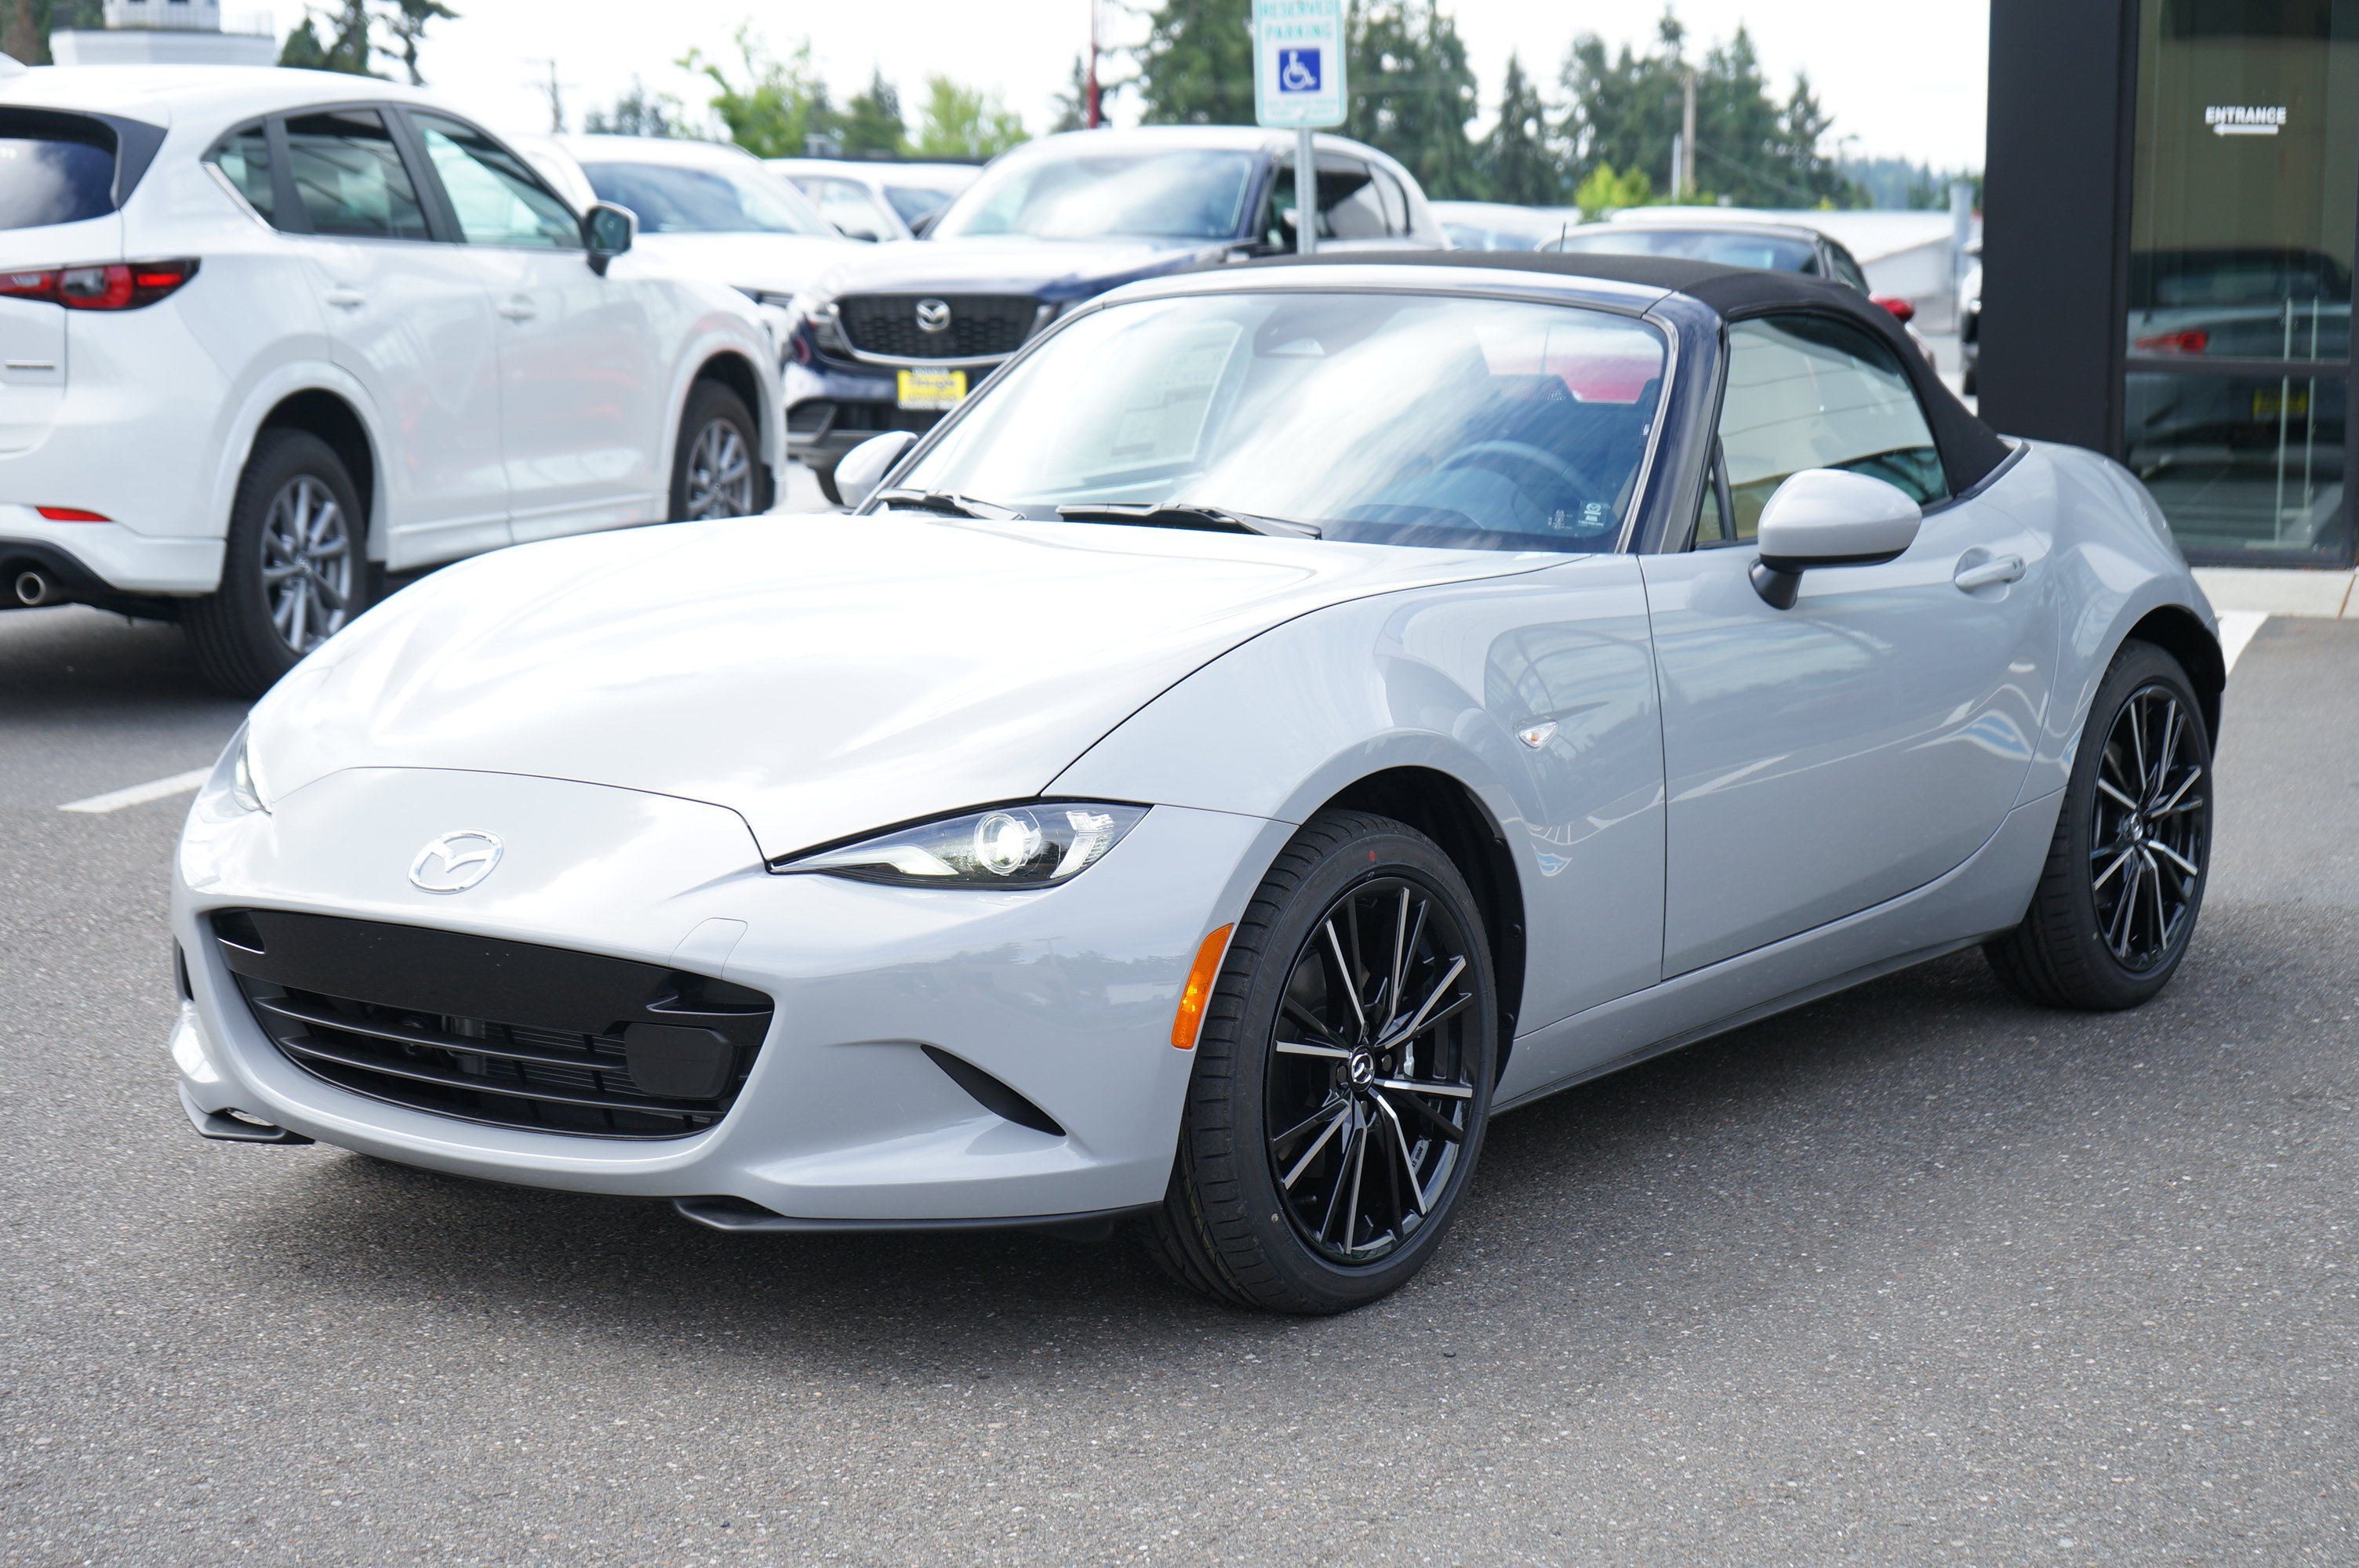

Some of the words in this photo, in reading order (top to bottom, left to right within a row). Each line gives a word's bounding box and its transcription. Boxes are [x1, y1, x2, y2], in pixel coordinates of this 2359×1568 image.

[1259, 1, 1334, 16] RESERVED
[1265, 22, 1332, 41] PARKING
[2205, 106, 2287, 124] ENTRANCE
